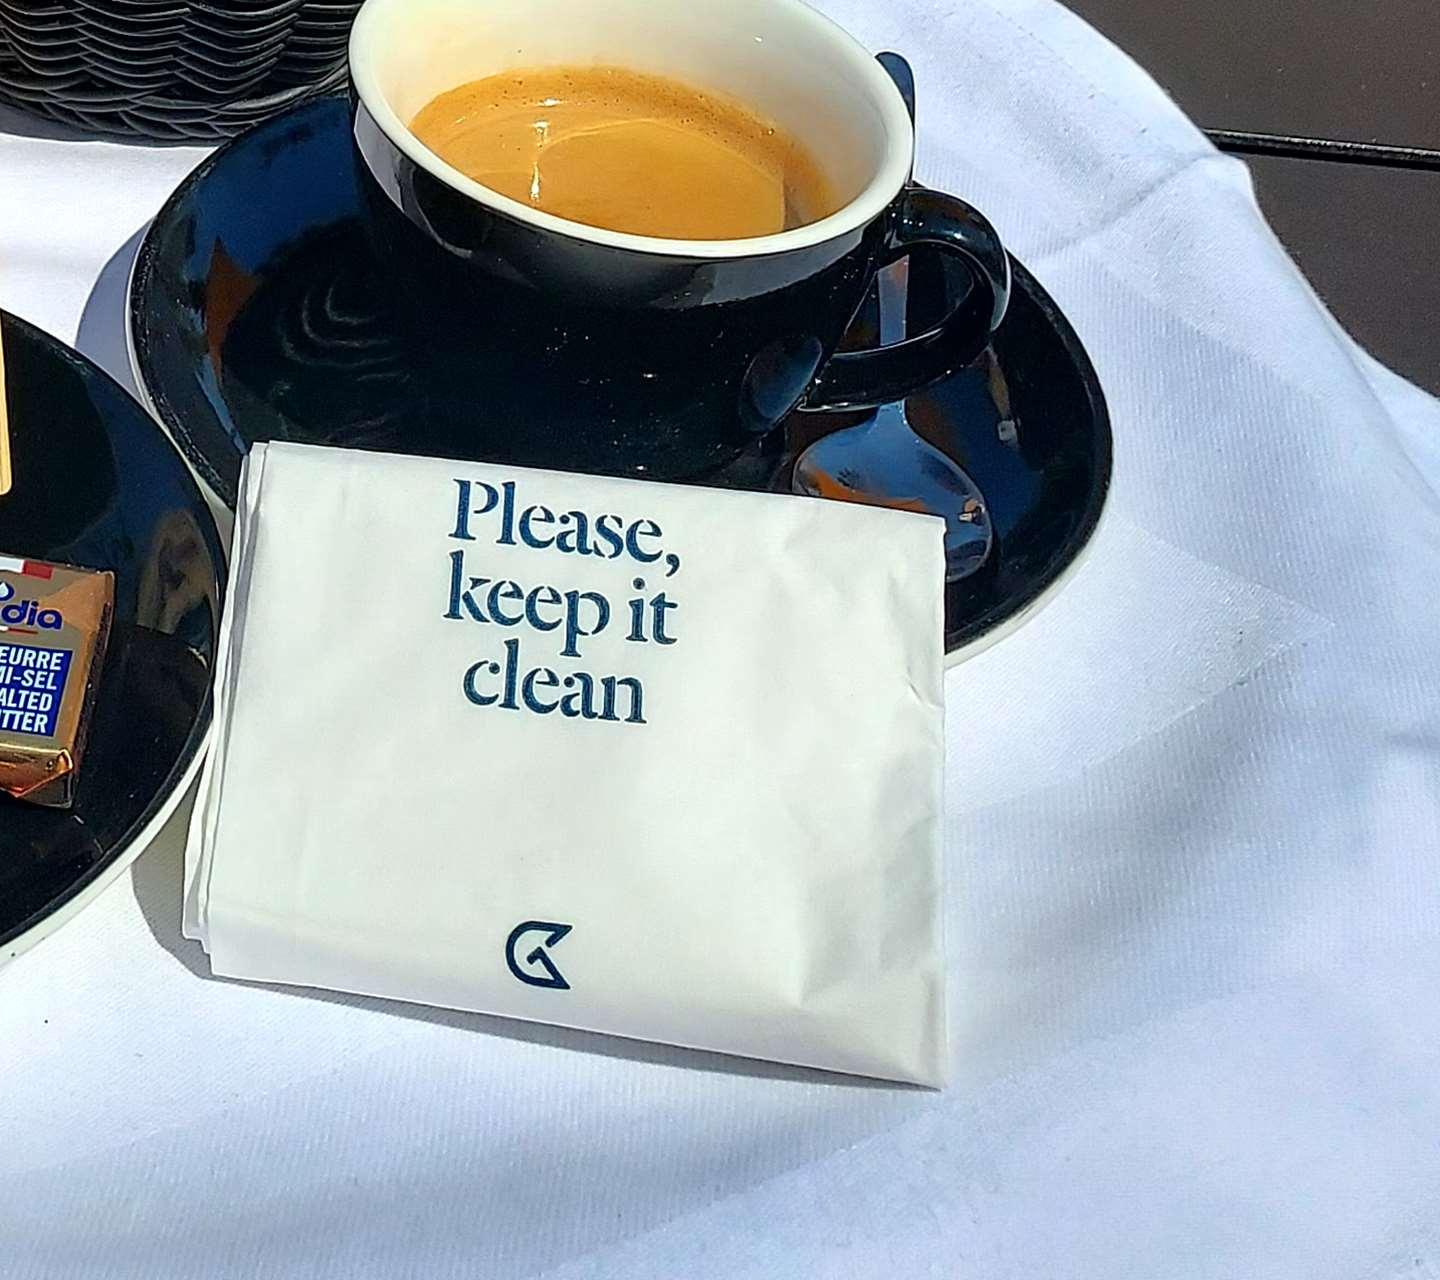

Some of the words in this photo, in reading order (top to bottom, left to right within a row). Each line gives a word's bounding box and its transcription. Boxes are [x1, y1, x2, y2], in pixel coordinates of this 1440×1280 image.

[447, 478, 681, 577] Please,
[443, 550, 611, 657] keep
[626, 576, 678, 645] it
[462, 638, 648, 724] clean
